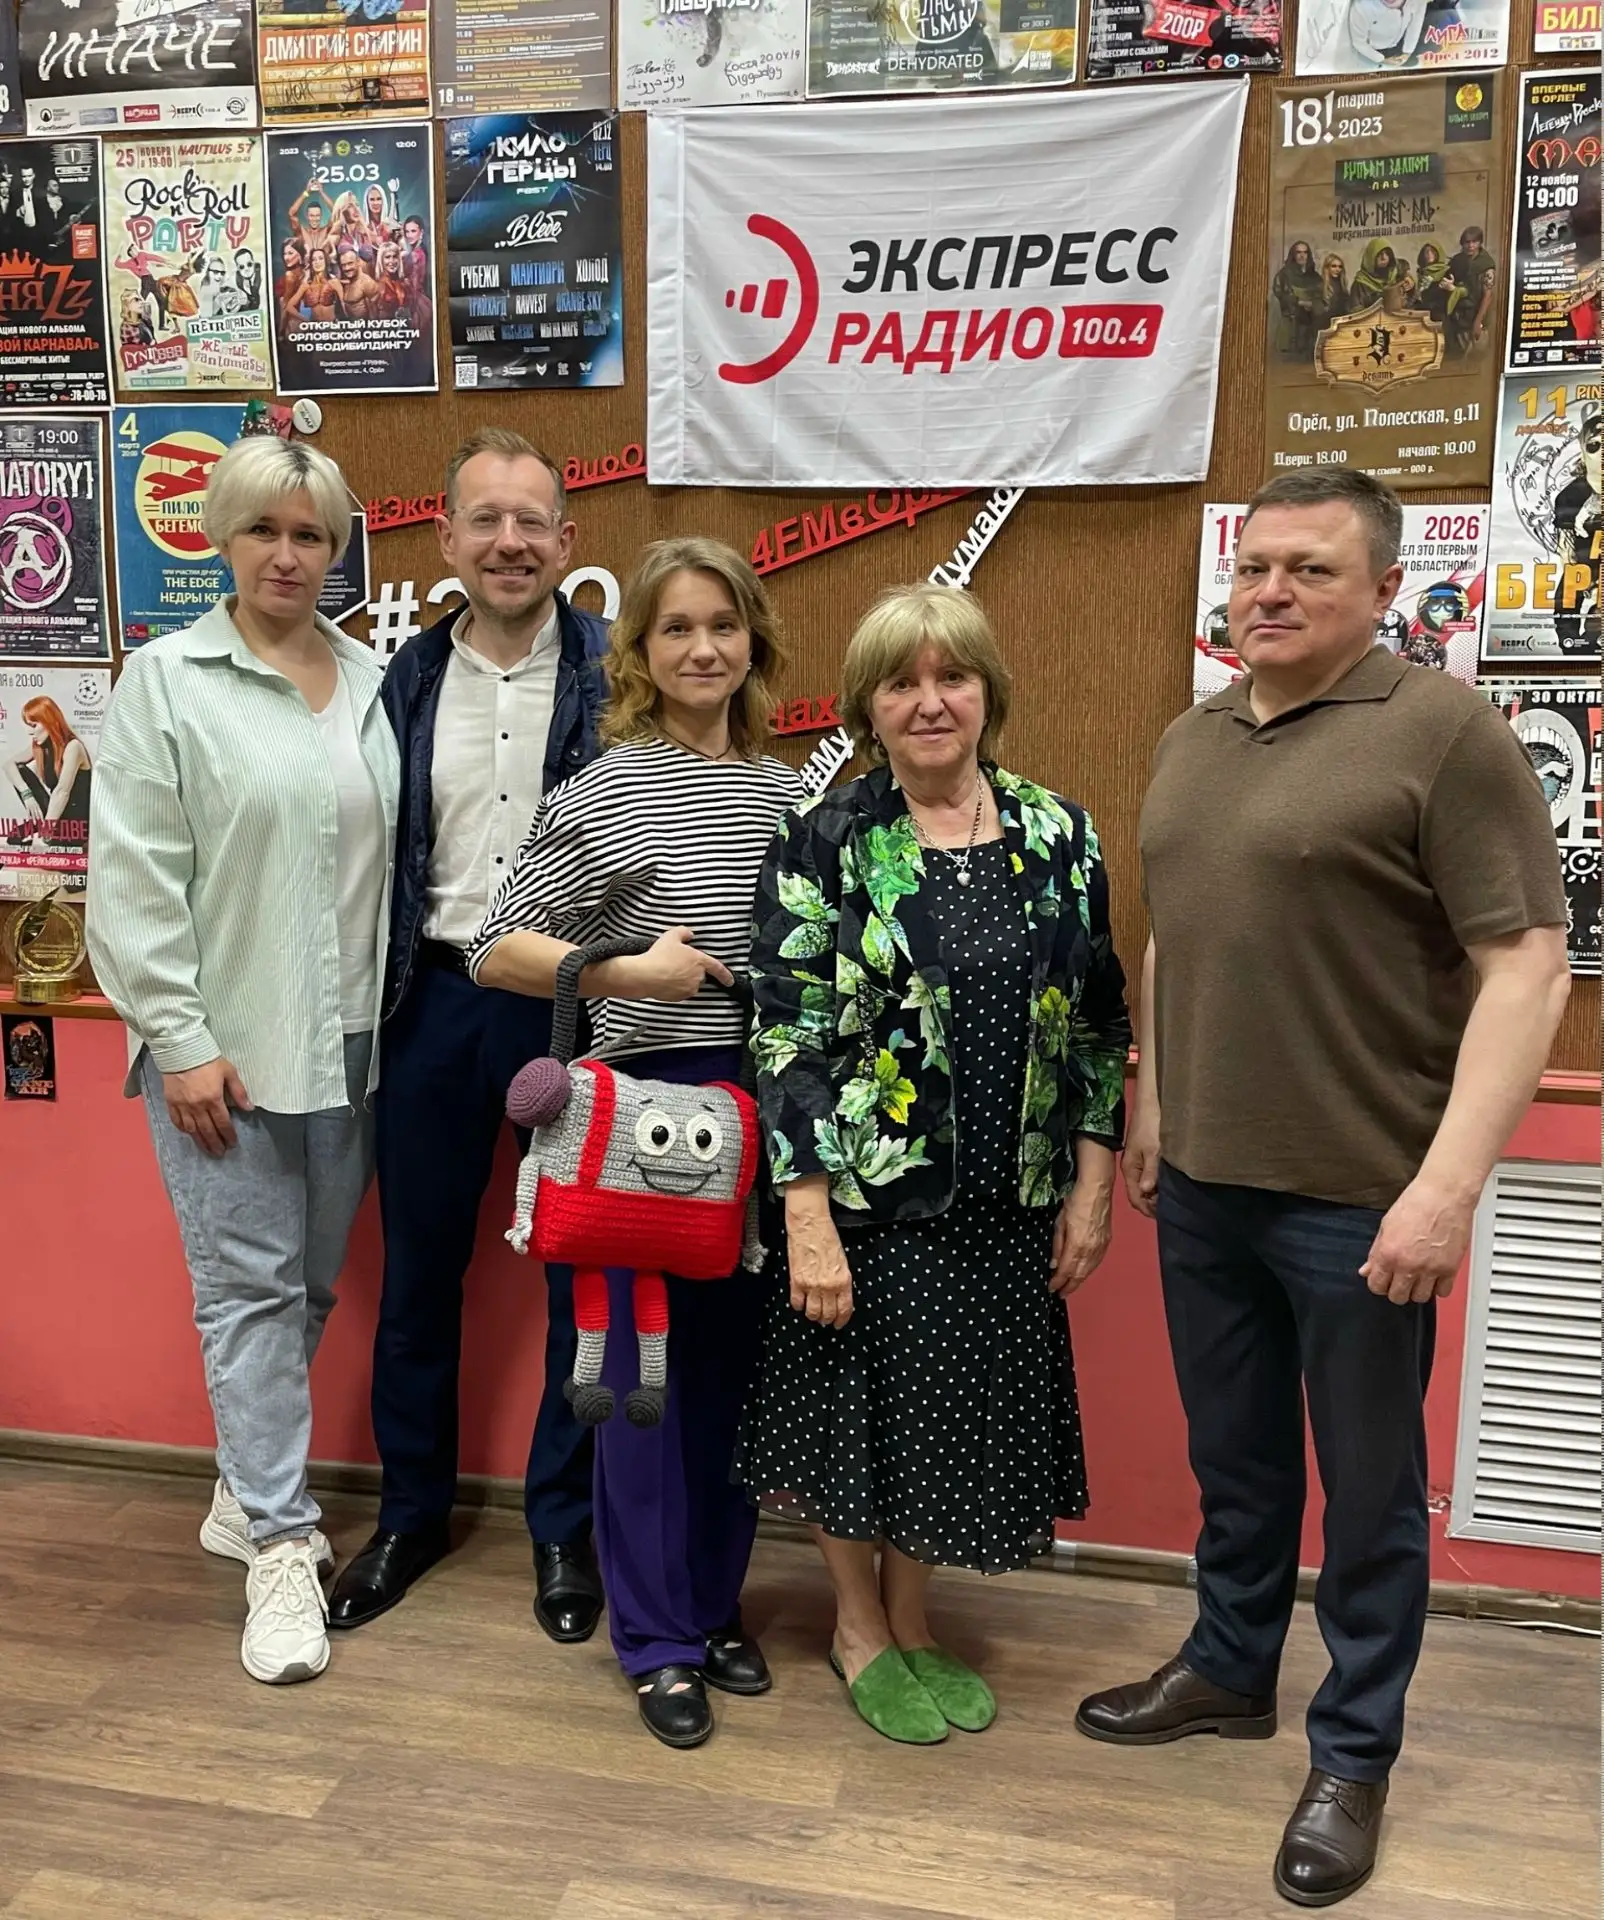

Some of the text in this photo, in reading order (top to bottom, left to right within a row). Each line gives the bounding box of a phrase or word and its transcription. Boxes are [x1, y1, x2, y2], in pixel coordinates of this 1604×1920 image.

[916, 8, 973, 39] ТЬМЫ
[1543, 6, 1602, 30] БИЛ
[38, 18, 243, 82] ИНАЧЕ
[263, 28, 422, 64] ДМИТРИЙ СПИРИН
[1464, 48, 1499, 60] 2012
[887, 53, 984, 72] DEHYDRATED
[439, 88, 454, 103] 18
[1531, 93, 1576, 104] В ОРЛЕ!
[1532, 83, 1587, 95] ВПЕРВЫЕ
[1337, 91, 1384, 110] марта
[1279, 89, 1335, 147] 18!
[1338, 116, 1383, 139] 2023
[177, 143, 253, 156] NAUTILUS 57
[396, 140, 417, 149] 12:00
[496, 132, 568, 159] КИЛО
[115, 149, 135, 168] 25
[316, 162, 380, 184] 25.03
[487, 156, 578, 185] ГЕРЦЫ
[1526, 173, 1579, 187] 12 ноября
[516, 186, 549, 195] FEST
[1526, 187, 1579, 209] 19:00
[187, 182, 250, 228] Roll
[124, 214, 252, 253] PARTY
[1332, 223, 1436, 242] презентация альбома
[841, 226, 1177, 293] ЭКСПРЕСС
[460, 263, 500, 290] РУБЕЖИ
[19, 326, 48, 334] НОВОГО
[49, 325, 86, 334] АЛЬБОМА
[299, 318, 408, 331] ОТКРЫТЫЙ КУБОК
[24, 337, 100, 351] КАРНАВАЛ»
[288, 329, 420, 342] ОРЛОВСКОЙ ОБЛАСТИ
[827, 306, 1149, 374] РАДИО 100.4
[296, 340, 412, 352] ПО БОДИБИЛДИНГУ
[1518, 384, 1568, 420] 11
[118, 412, 139, 442] 4
[1287, 402, 1481, 434] Орёл, ул. Полесская, д.11
[38, 429, 79, 444] 19:00
[1273, 449, 1348, 467] Двери: 18.00
[1397, 439, 1477, 459] начало: 19.00
[1424, 515, 1480, 541] 2026
[1400, 543, 1478, 557] ЕЛ ЭТО ПЕРВЫМ
[165, 577, 220, 589] THE EDGE
[1496, 563, 1602, 609] БЕР
[160, 591, 202, 605] НЕДРЫ
[16, 673, 44, 688] 20:00
[1531, 690, 1552, 704] 30
[60, 874, 87, 886] БИЛЕТ
[19, 886, 58, 897] 78-00-7
